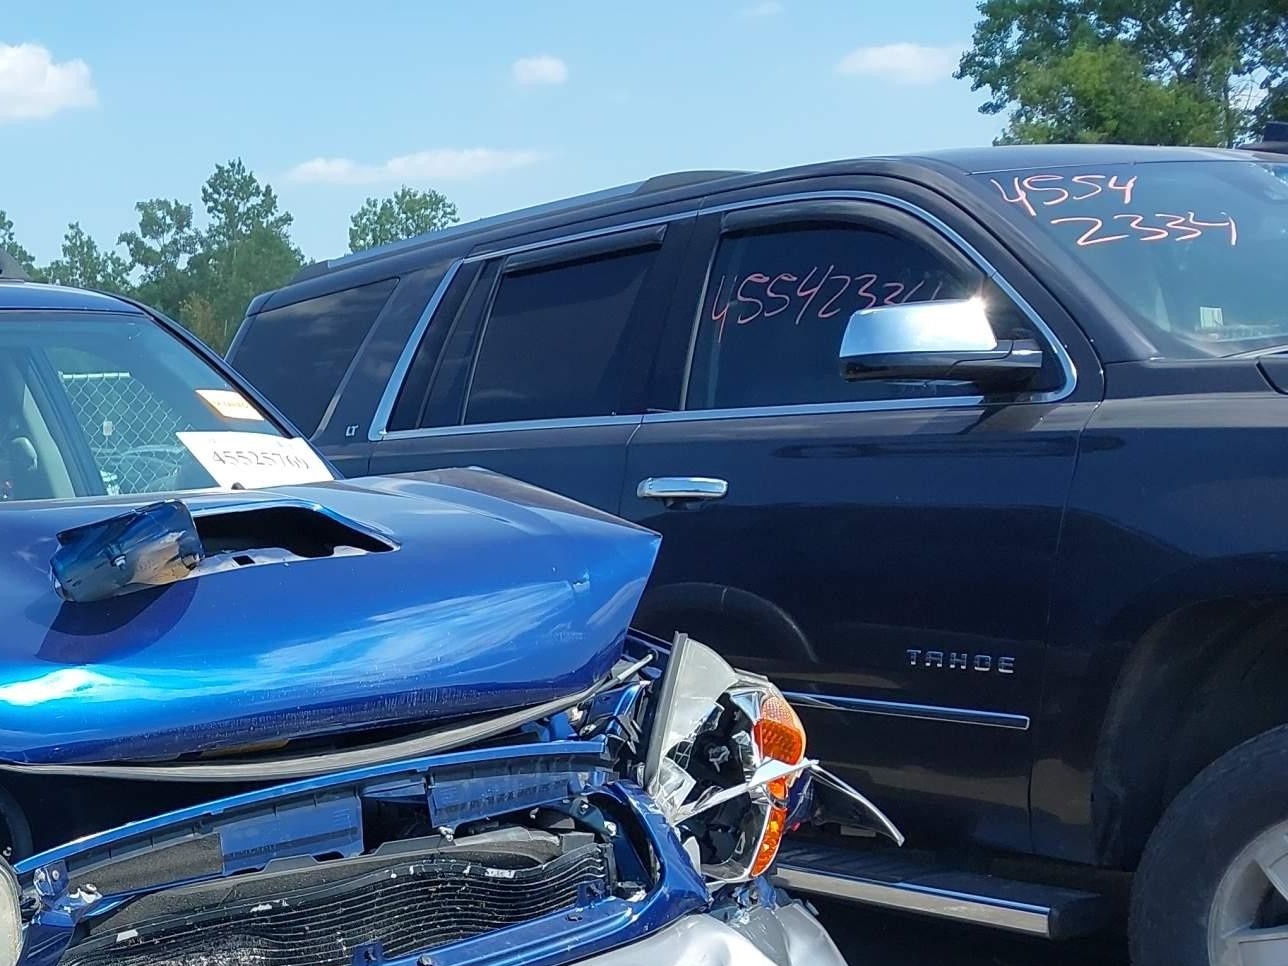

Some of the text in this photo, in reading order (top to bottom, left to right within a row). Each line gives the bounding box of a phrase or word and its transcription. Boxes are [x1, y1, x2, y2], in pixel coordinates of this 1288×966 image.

[990, 175, 1138, 216] 4554
[1050, 211, 1238, 246] 2334
[711, 264, 944, 344] 4554233
[906, 649, 1016, 674] TAHOE
